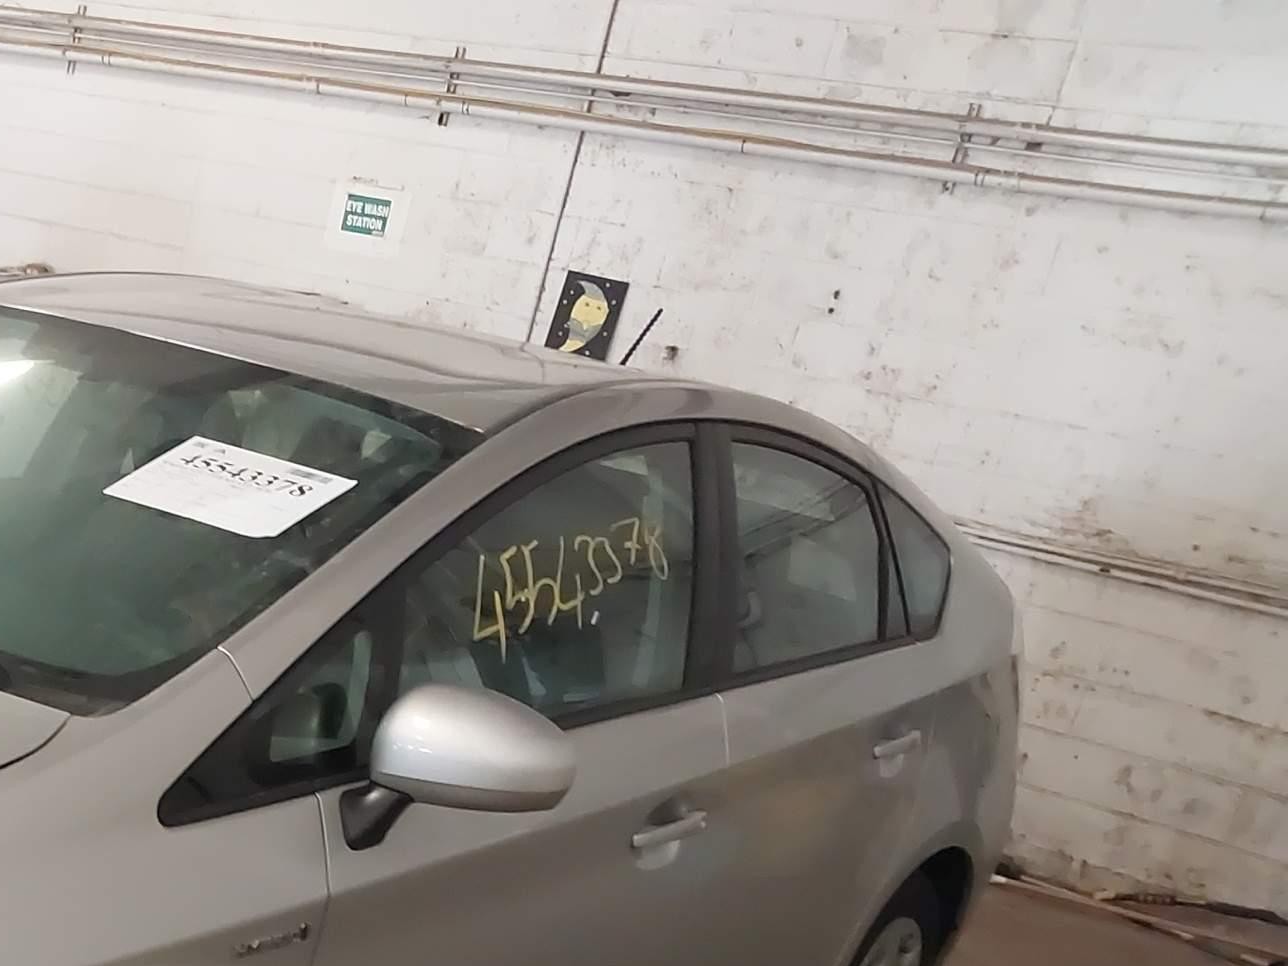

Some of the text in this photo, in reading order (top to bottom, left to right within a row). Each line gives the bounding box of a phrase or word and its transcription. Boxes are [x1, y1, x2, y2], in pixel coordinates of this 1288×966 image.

[346, 201, 364, 213] EYE
[346, 214, 383, 231] STATION
[180, 455, 314, 497] 45543378
[473, 518, 669, 664] 45543378
